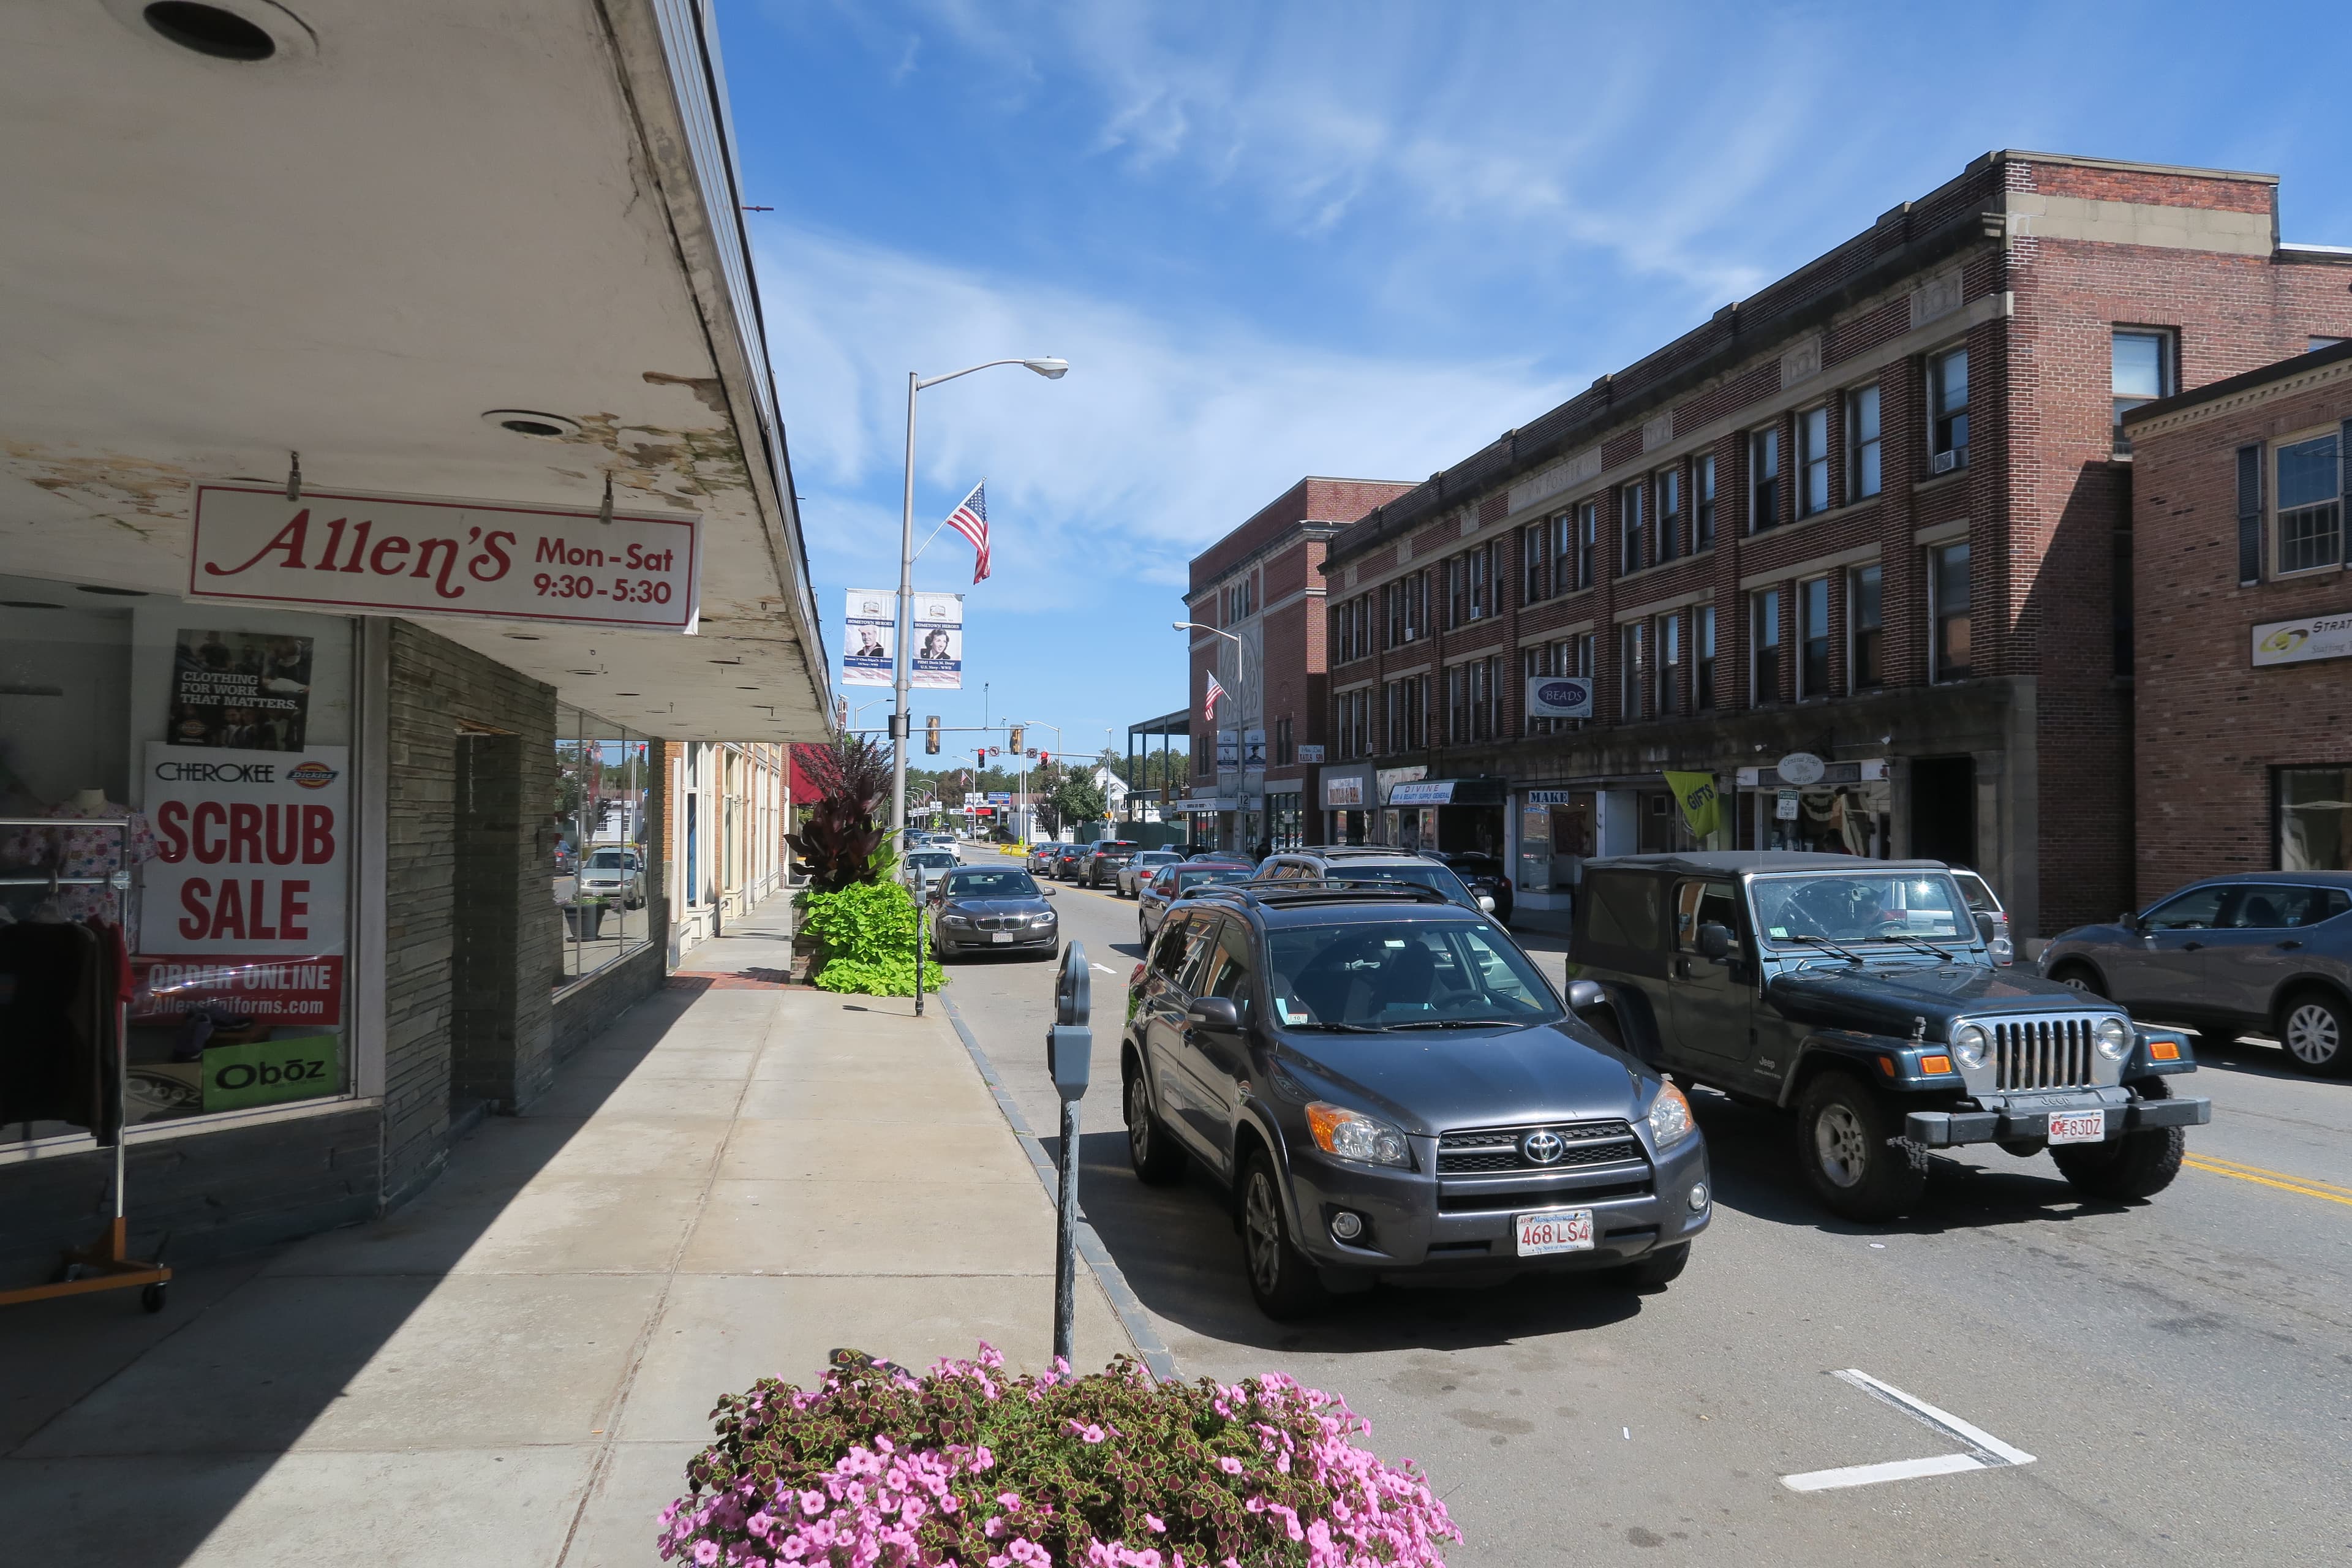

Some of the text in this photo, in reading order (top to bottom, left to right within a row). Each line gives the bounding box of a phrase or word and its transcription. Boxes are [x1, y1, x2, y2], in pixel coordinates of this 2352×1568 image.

[533, 573, 671, 605] 9:30-5:30
[182, 671, 258, 685] CLOTHING
[181, 682, 258, 696] FOR WORK
[1545, 690, 1583, 701] BEADS
[181, 693, 299, 710] THAT MATTERS.
[1299, 753, 1313, 762] NAILS
[156, 762, 275, 783] CHEROKEE
[1404, 784, 1439, 793] DIVINE
[1240, 795, 1248, 804] 12
[1531, 792, 1567, 803] MAKE
[1687, 783, 1714, 810] GIFTS
[157, 800, 336, 865] SCRUB
[178, 877, 310, 940] SALE
[149, 963, 331, 990] ORDER ONLINE
[2040, 1097, 2071, 1107] Jeep
[1521, 1221, 1588, 1246] 468 LS4
